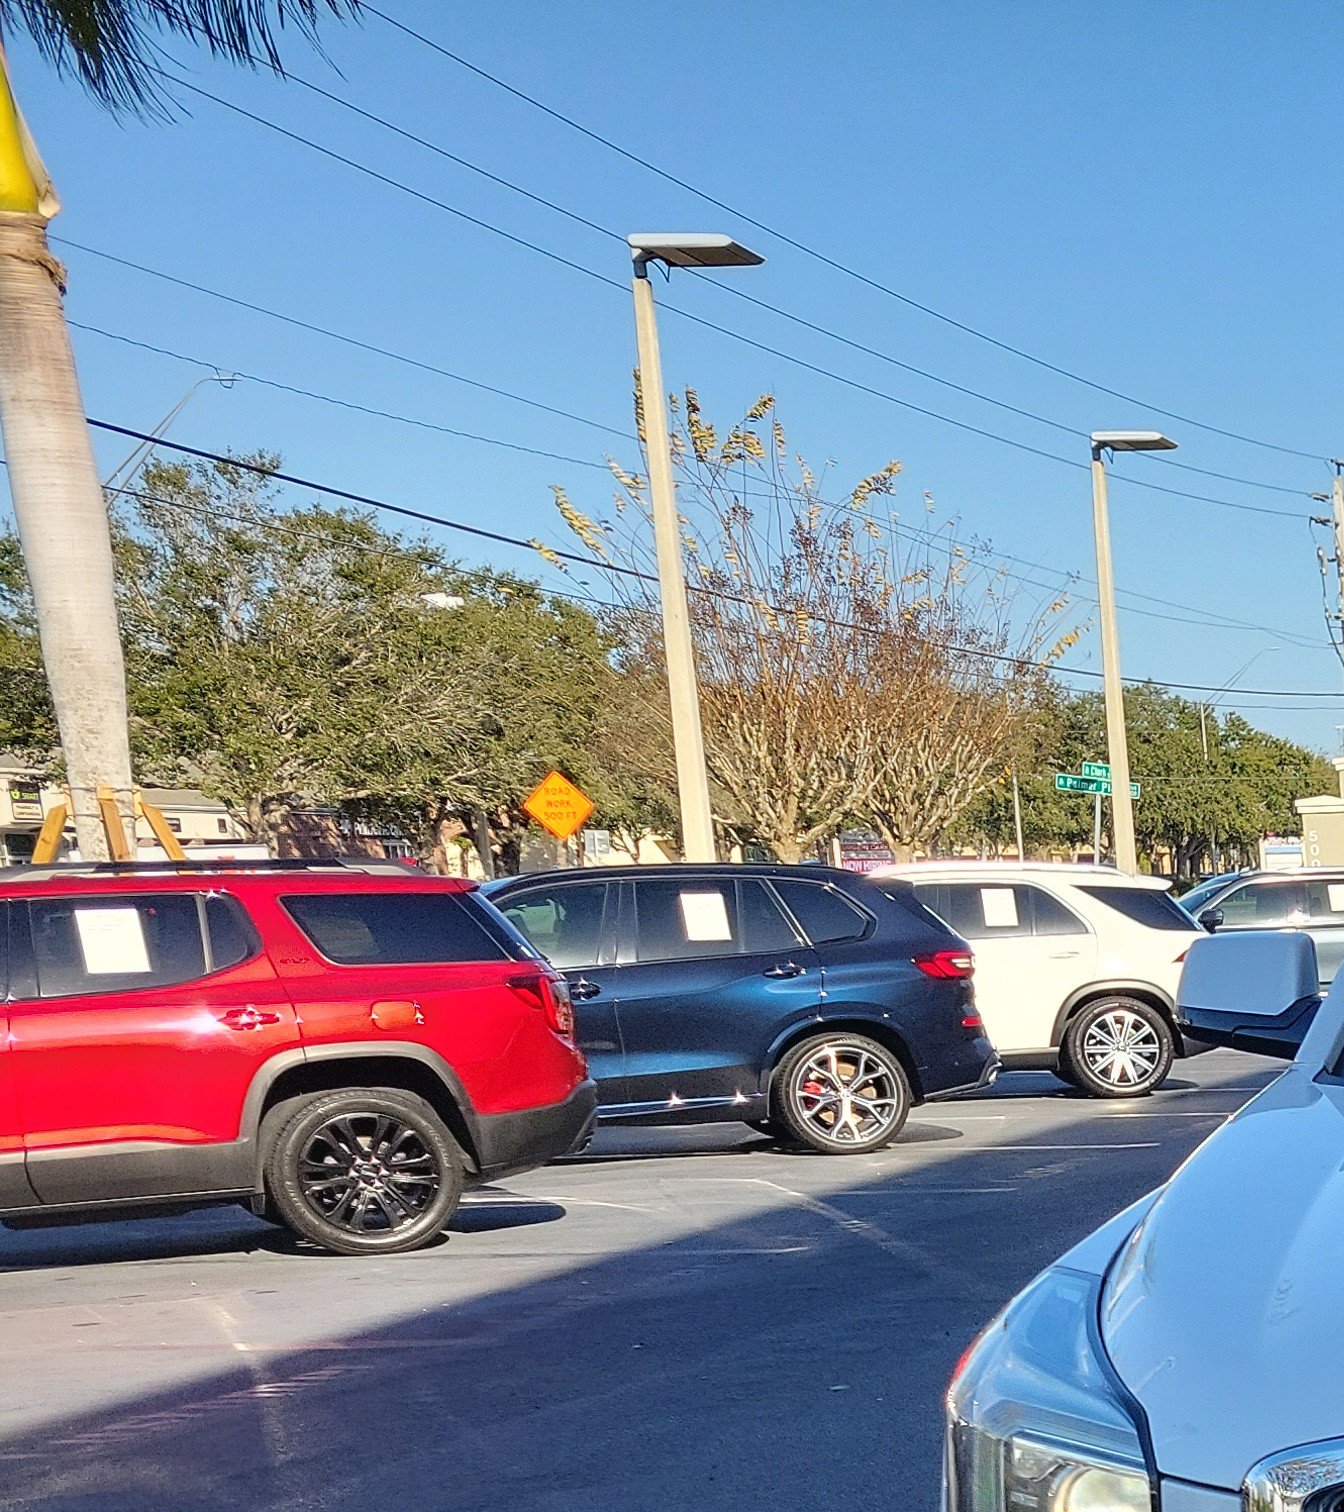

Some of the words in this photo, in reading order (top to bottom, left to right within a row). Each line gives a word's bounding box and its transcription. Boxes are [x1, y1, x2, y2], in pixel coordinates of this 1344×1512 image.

[544, 787, 570, 795] ROAD
[546, 800, 573, 808] WORK
[544, 811, 563, 820] 500
[566, 811, 577, 820] FT
